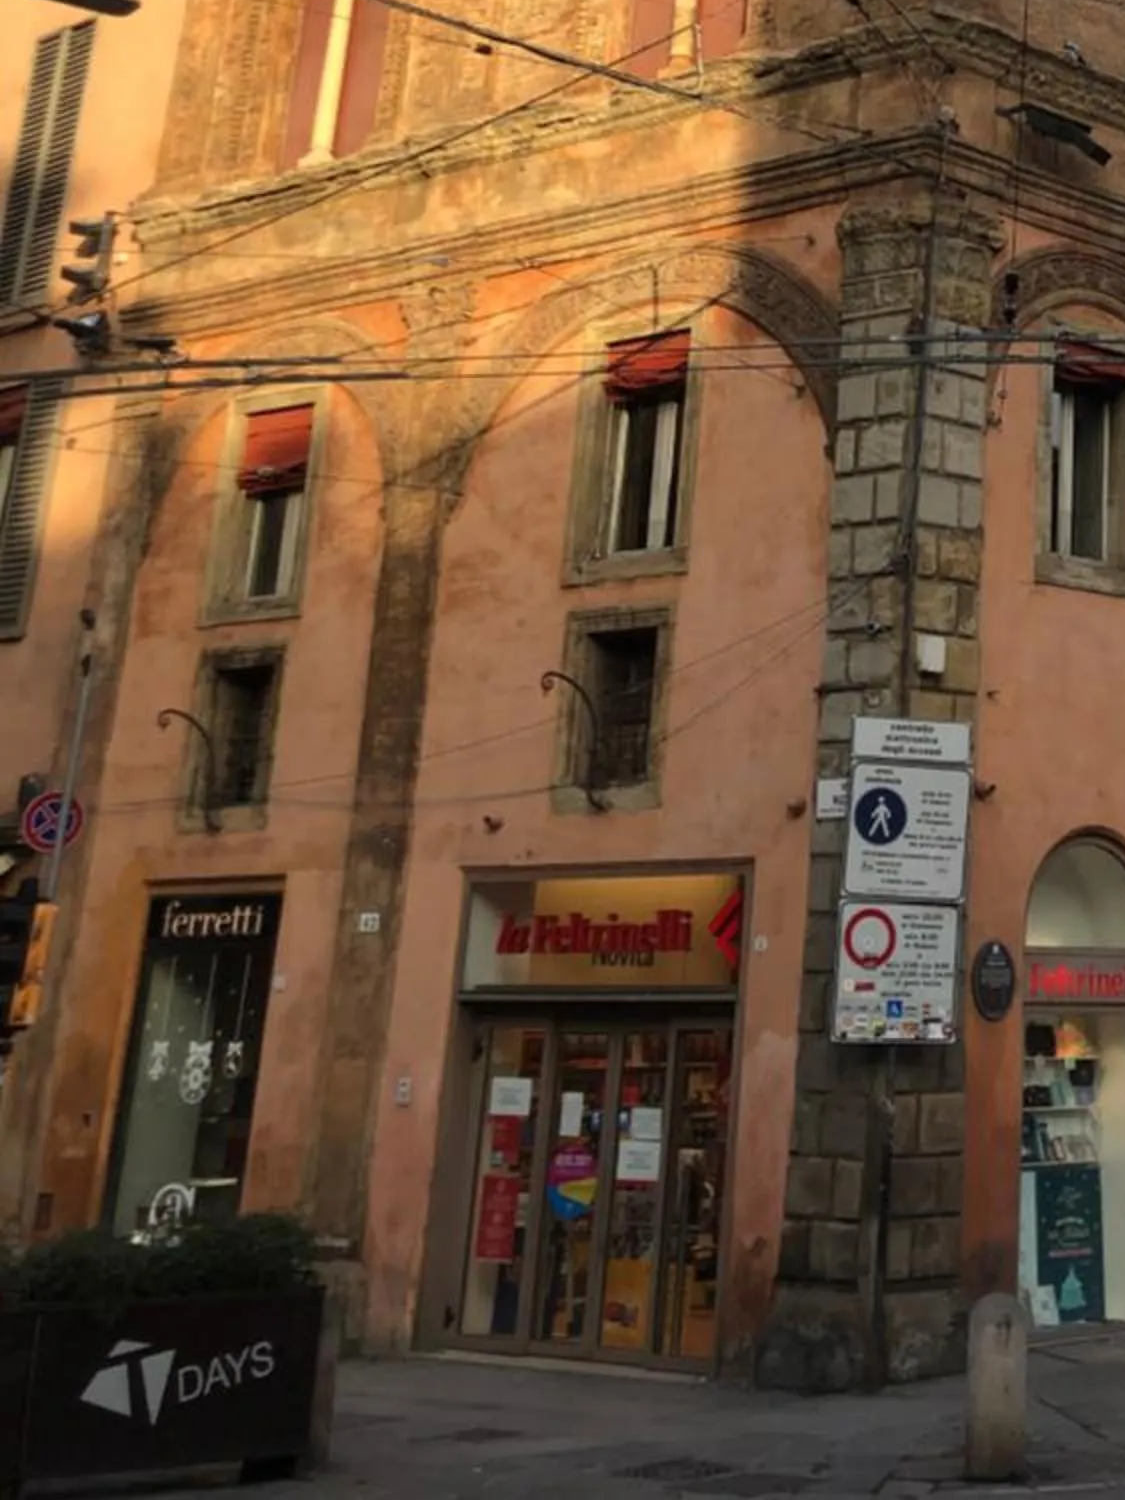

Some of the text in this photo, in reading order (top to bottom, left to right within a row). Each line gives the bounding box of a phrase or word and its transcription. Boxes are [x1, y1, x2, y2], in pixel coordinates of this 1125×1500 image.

[162, 901, 264, 937] ferretti
[534, 910, 694, 954] Feltrinelli
[177, 1341, 275, 1403] DAYS
